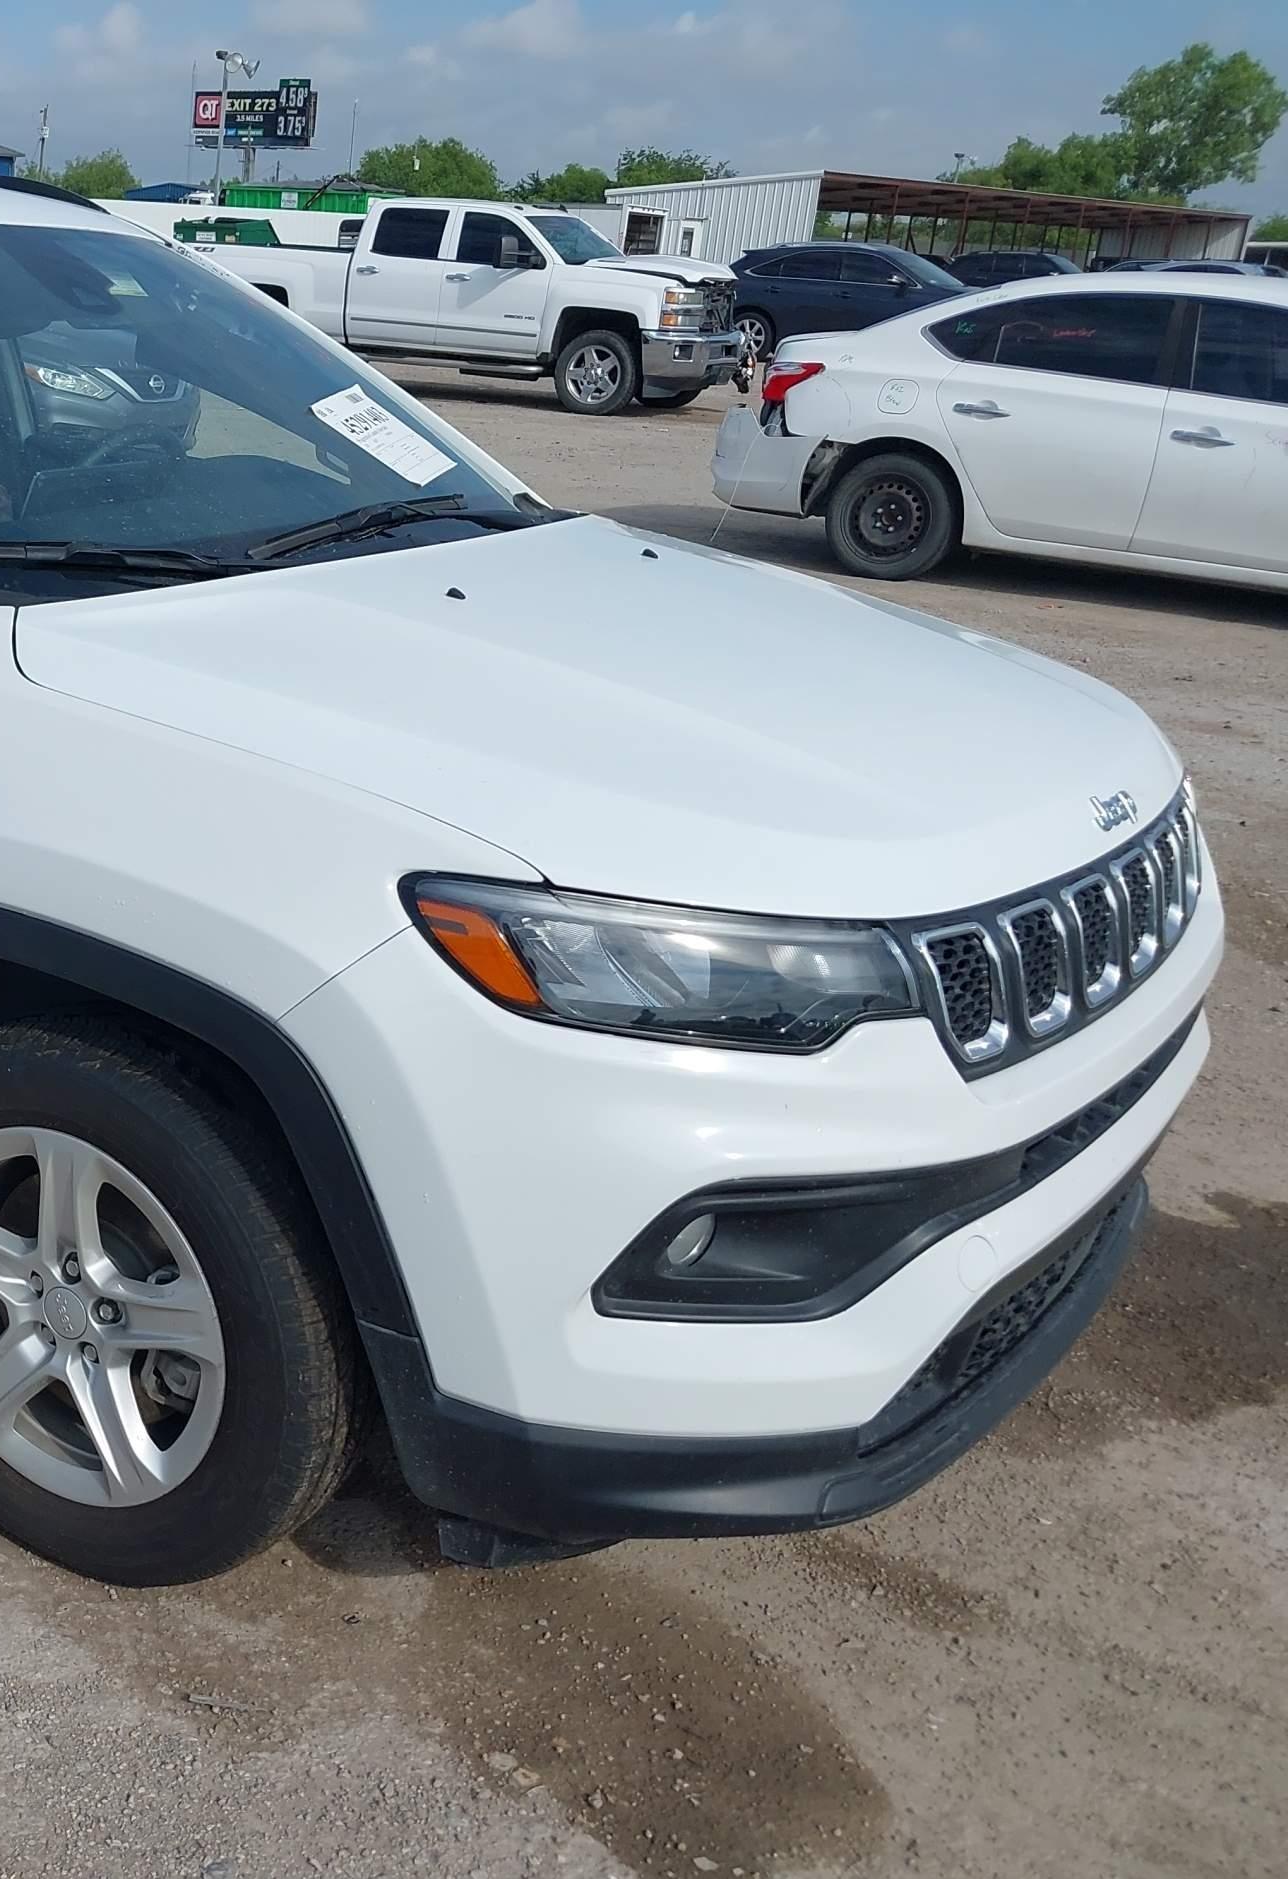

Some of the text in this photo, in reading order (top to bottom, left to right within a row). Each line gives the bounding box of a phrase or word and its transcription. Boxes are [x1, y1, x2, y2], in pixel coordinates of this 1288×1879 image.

[199, 99, 219, 119] QT
[226, 98, 277, 111] EXIT 273
[246, 114, 264, 122] MILES
